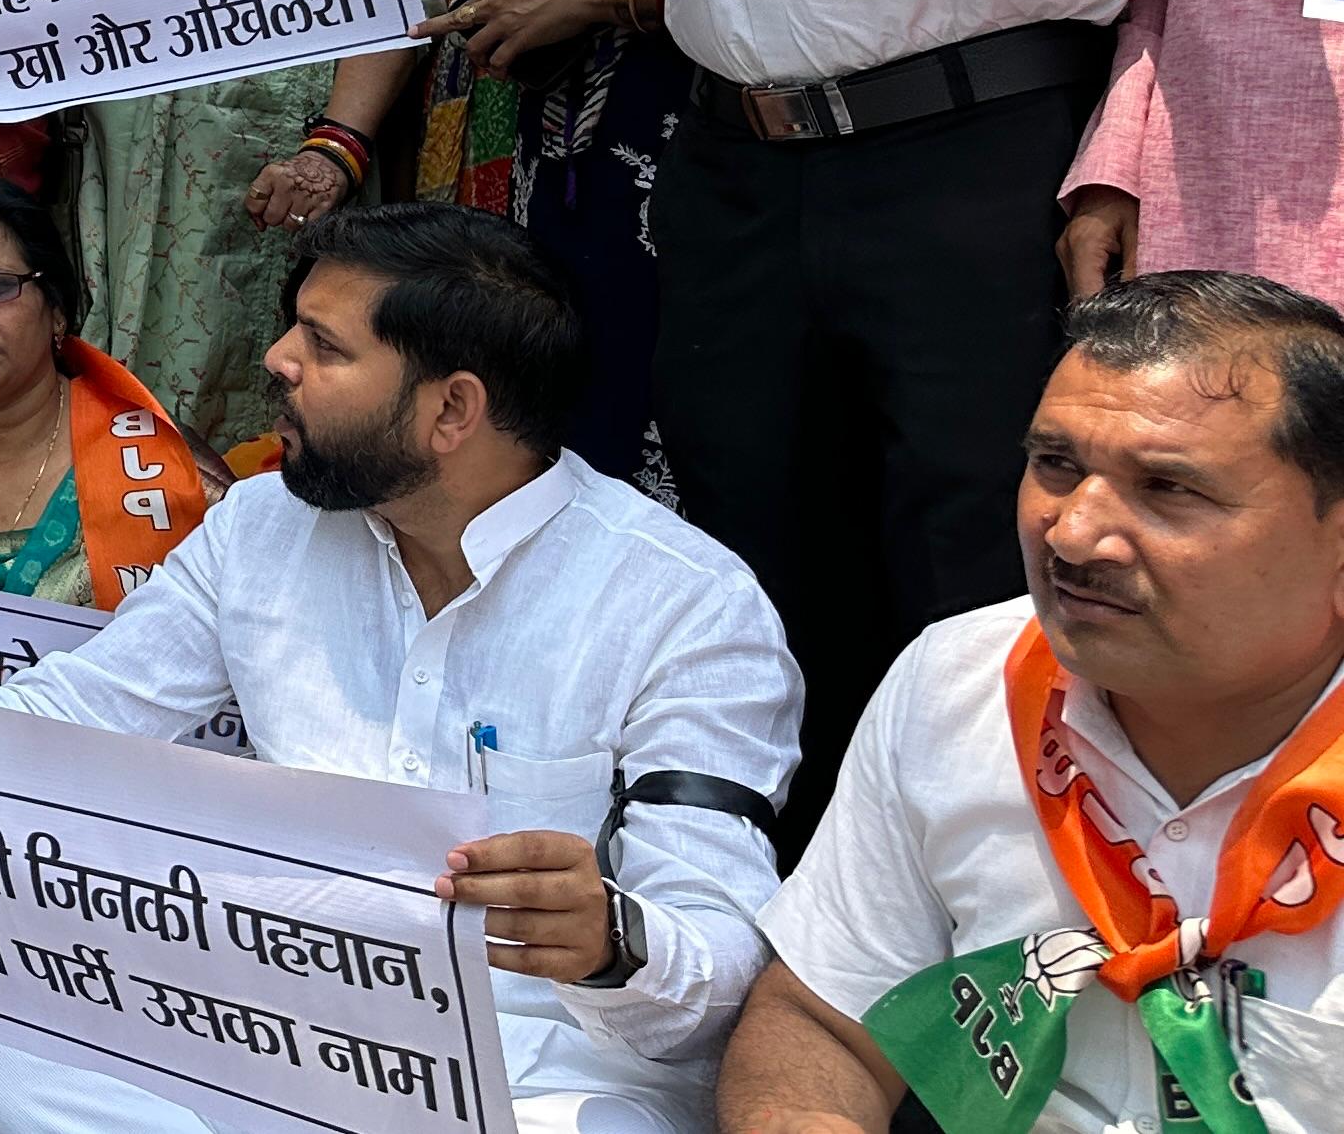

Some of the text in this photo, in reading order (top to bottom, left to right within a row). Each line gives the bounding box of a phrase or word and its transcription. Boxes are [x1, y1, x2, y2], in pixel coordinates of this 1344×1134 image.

[6, 23, 65, 89] खां
[74, 14, 153, 75] और
[24, 832, 210, 951] जिनकी
[222, 902, 449, 1013] पहचान,
[11, 939, 123, 1012] पार्टी
[129, 974, 301, 1067] उसका
[310, 1024, 468, 1122] नाम।
